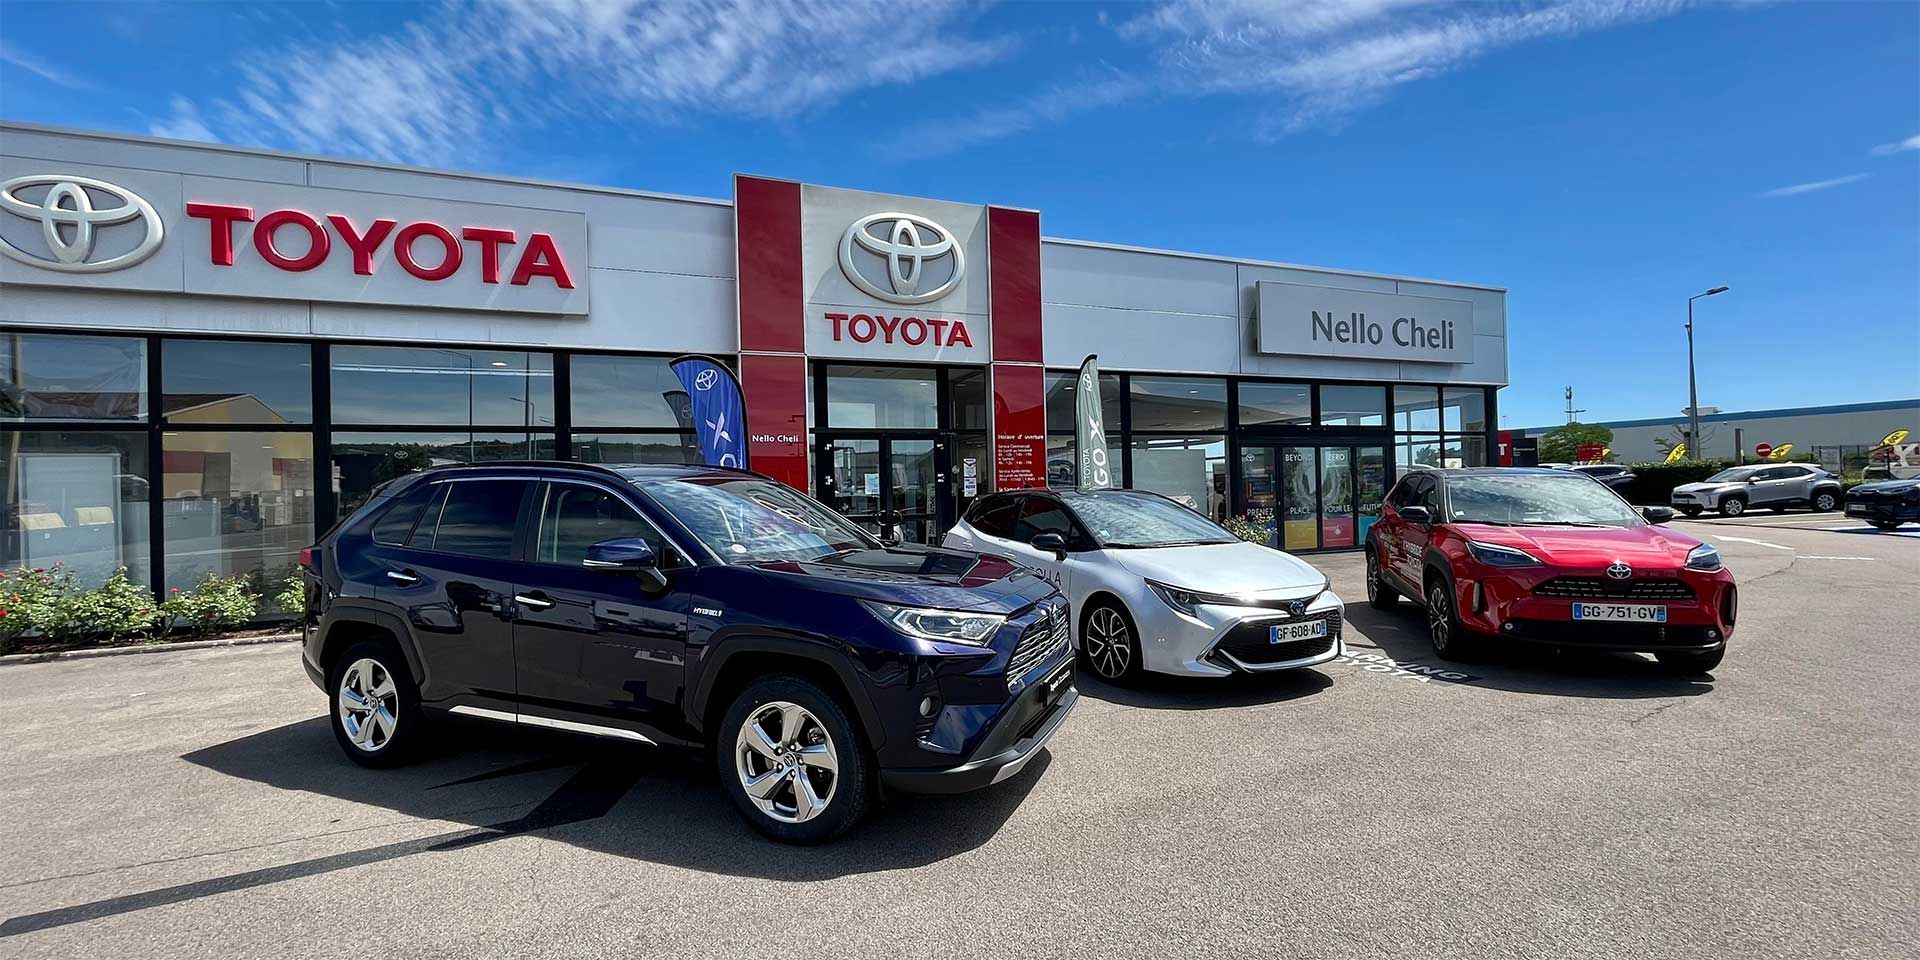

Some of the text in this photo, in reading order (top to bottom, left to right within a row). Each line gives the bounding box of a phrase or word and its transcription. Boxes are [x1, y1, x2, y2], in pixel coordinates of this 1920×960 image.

[186, 202, 575, 288] TOYOTA
[824, 312, 973, 348] TOYOTA
[1311, 311, 1454, 349] Nello Cheli
[752, 434, 799, 443] Nello Cheli
[1082, 448, 1091, 479] TOYOTA
[1284, 453, 1345, 462] BEYOND ZERO
[1246, 507, 1274, 517] PRENEZ
[1290, 507, 1311, 515] PLACE
[1324, 505, 1343, 513] POUR
[1343, 504, 1351, 513] LE
[1582, 605, 1656, 619] GG-751-GV
[1276, 623, 1321, 640] GF-608-AD
[1332, 655, 1432, 683] OYOTA
[1345, 650, 1468, 680] ARKING
